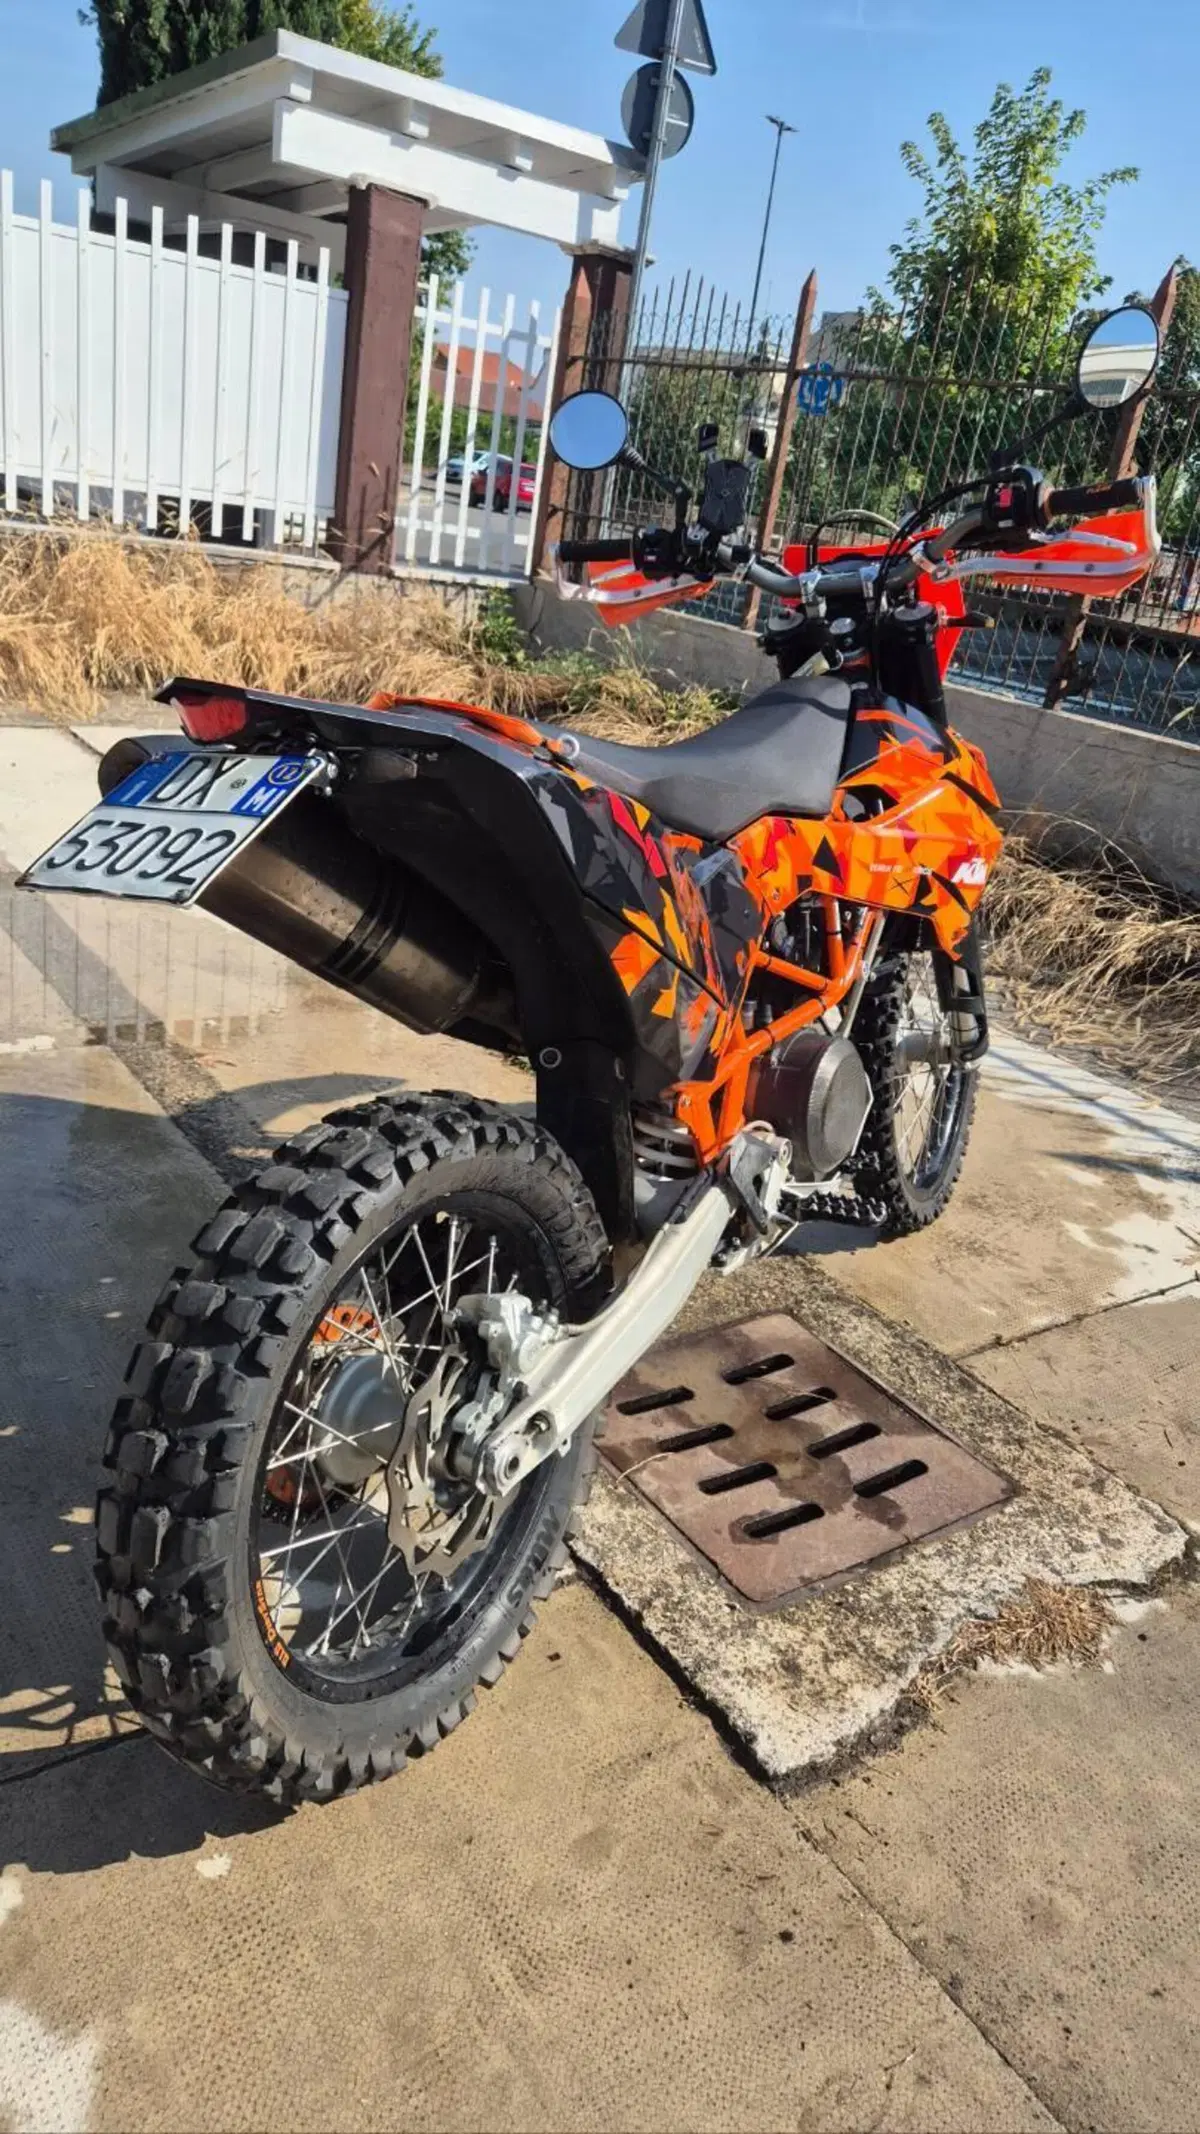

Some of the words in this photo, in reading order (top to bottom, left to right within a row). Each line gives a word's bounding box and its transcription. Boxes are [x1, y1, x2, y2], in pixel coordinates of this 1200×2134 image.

[147, 757, 247, 806] DX
[242, 787, 287, 814] MI
[46, 818, 237, 885] 53092
